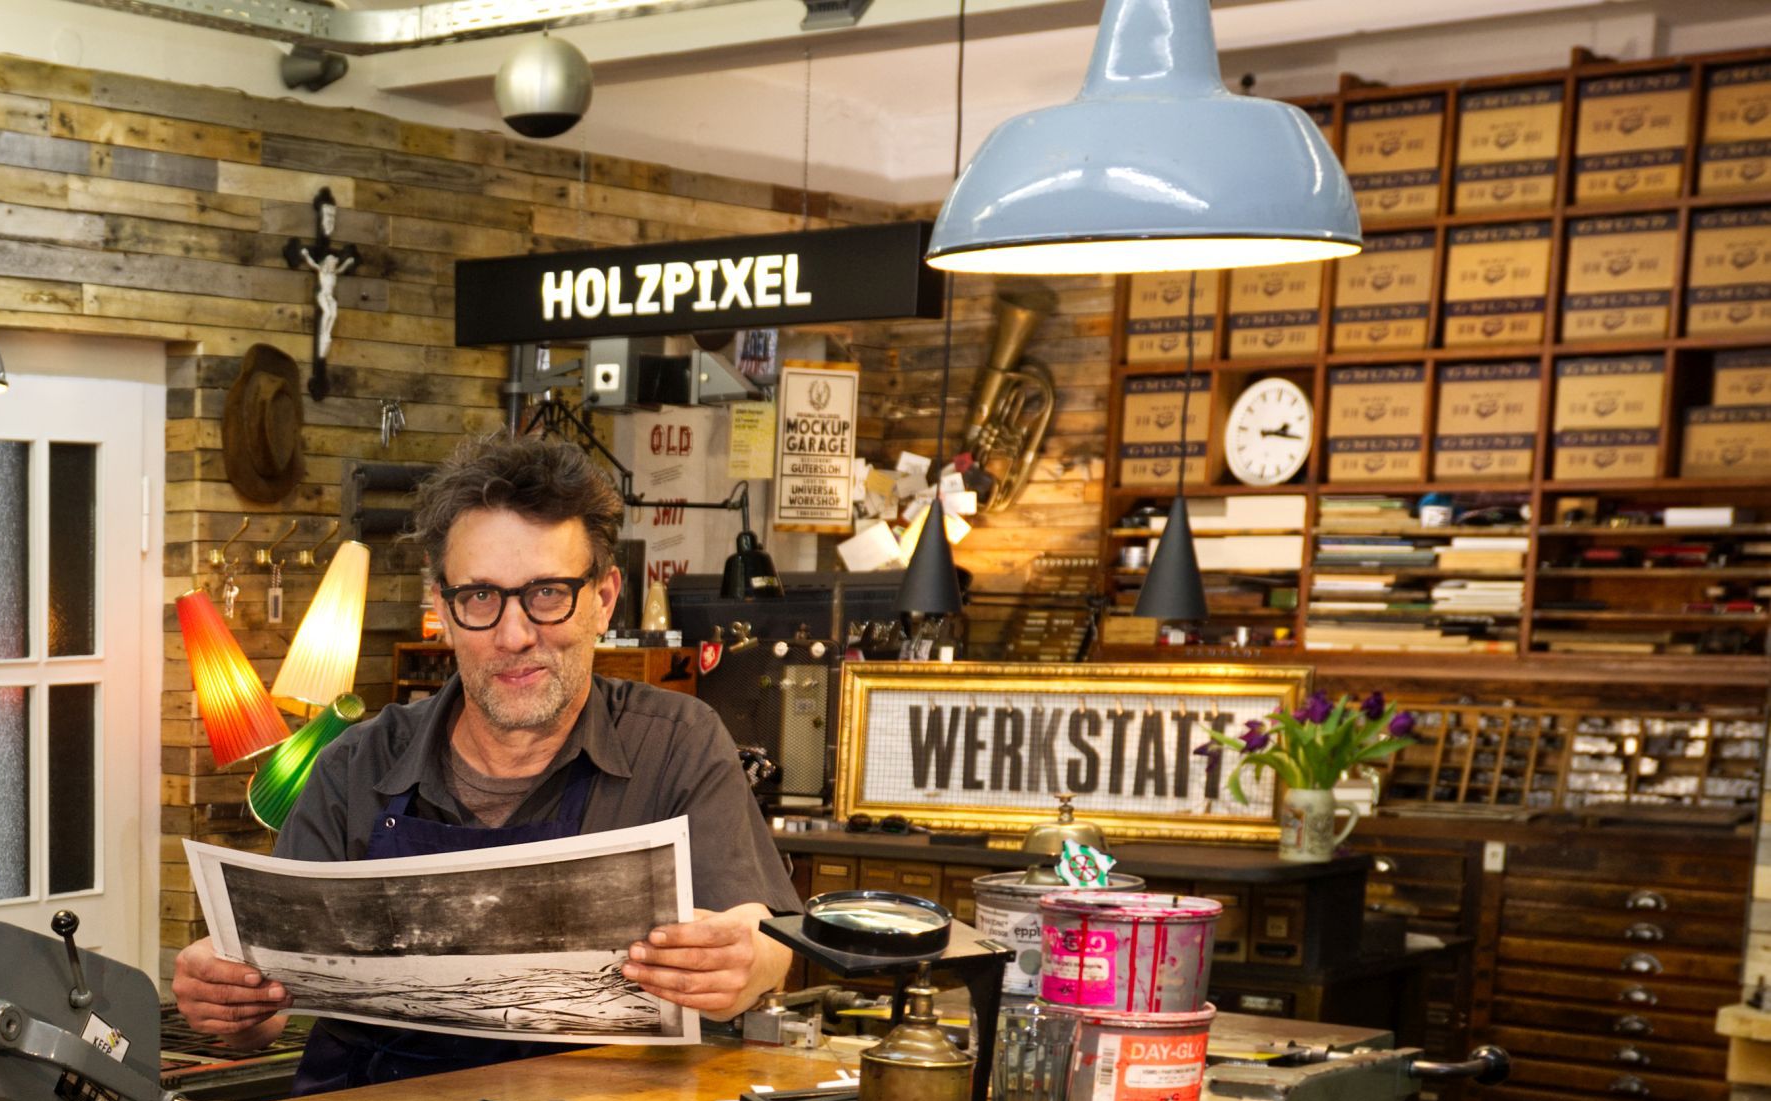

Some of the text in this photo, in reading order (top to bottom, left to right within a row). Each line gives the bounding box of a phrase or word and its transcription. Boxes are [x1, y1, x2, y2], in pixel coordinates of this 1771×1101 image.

[541, 253, 812, 320] HOLZPIXEL
[786, 418, 850, 436] MOCKUP
[650, 424, 693, 456] OLD
[786, 435, 847, 453] GARAGE
[791, 485, 838, 496] UNIVERSAL
[789, 496, 841, 506] WORKSHOP
[908, 705, 1236, 796] WERKSTATT
[1014, 921, 1041, 938] eppl
[93, 1036, 112, 1054] KEEP
[1130, 1041, 1203, 1060] DAY-GLO
